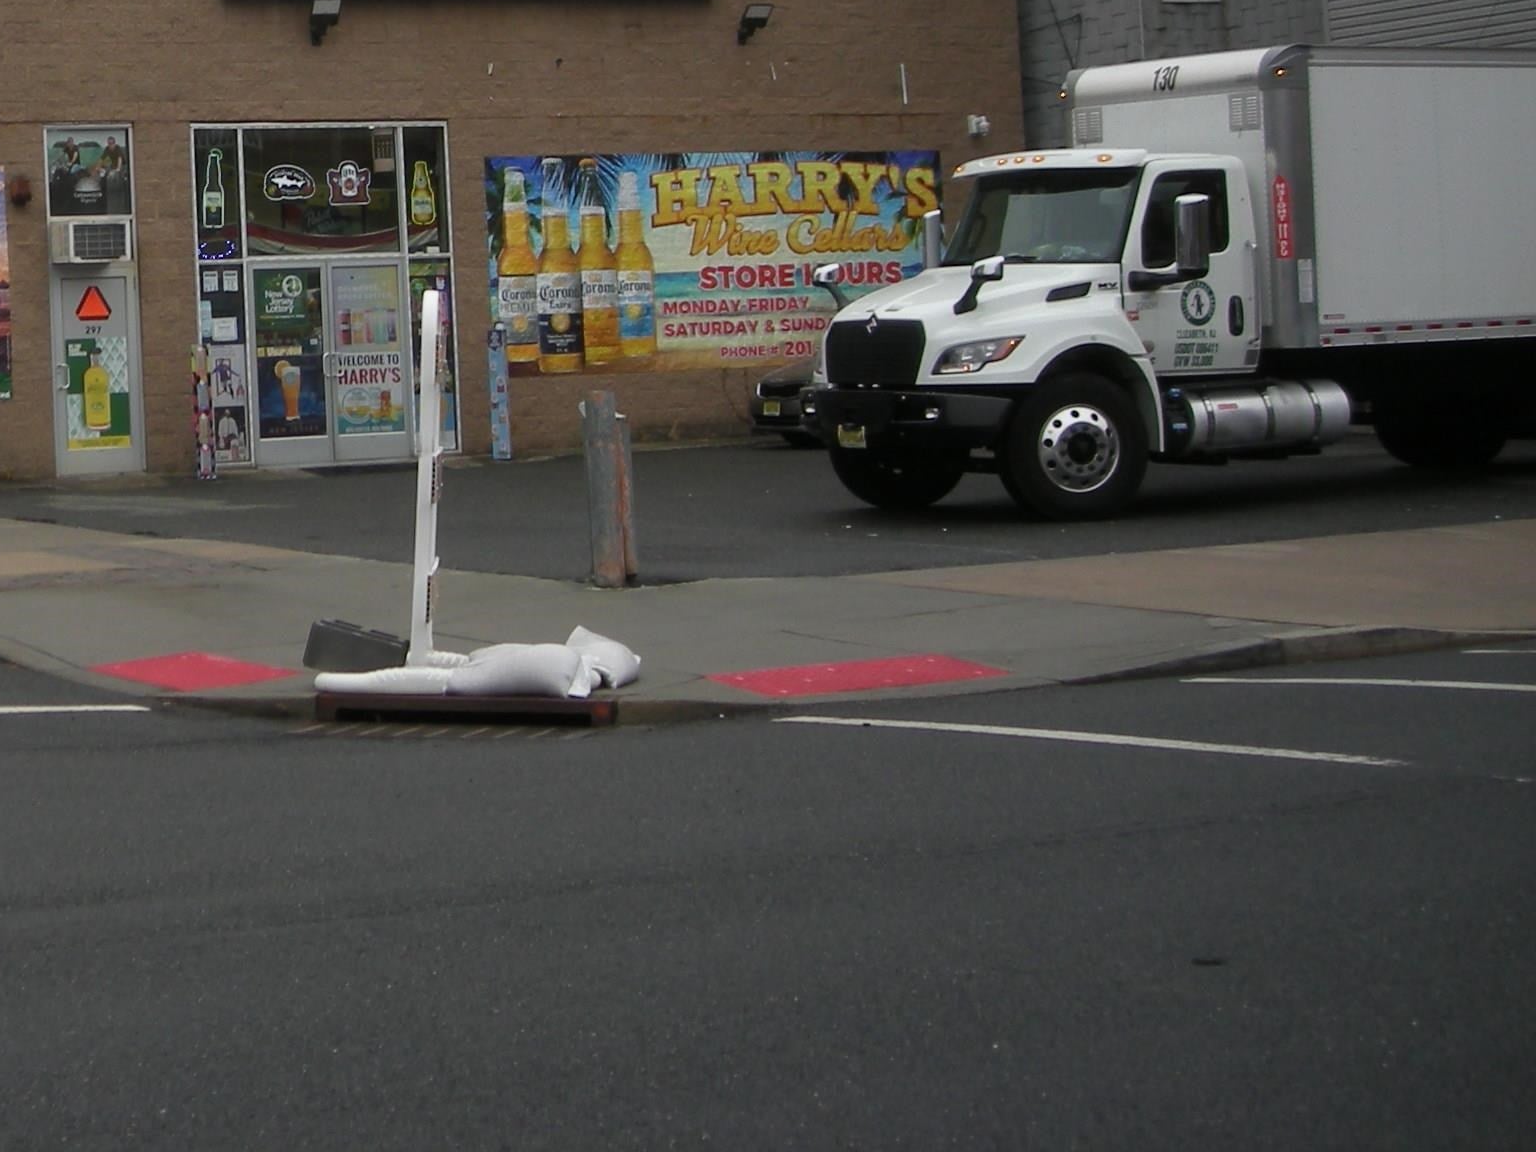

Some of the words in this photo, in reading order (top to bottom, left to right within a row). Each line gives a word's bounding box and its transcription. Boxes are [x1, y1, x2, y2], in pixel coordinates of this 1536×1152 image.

[1153, 65, 1180, 92] 130
[650, 160, 940, 228] HARRY'S
[686, 213, 780, 257] Wine
[786, 208, 911, 256] Cellars
[699, 265, 795, 289] STORE
[265, 289, 283, 299] New
[265, 304, 295, 314] Lottery
[85, 326, 102, 335] 297
[664, 319, 759, 338] SATURDAY
[765, 319, 775, 334] &
[780, 316, 833, 333] SUND
[387, 353, 400, 366] TO
[720, 344, 766, 358] PHONE
[338, 367, 401, 385] HARRY'S
